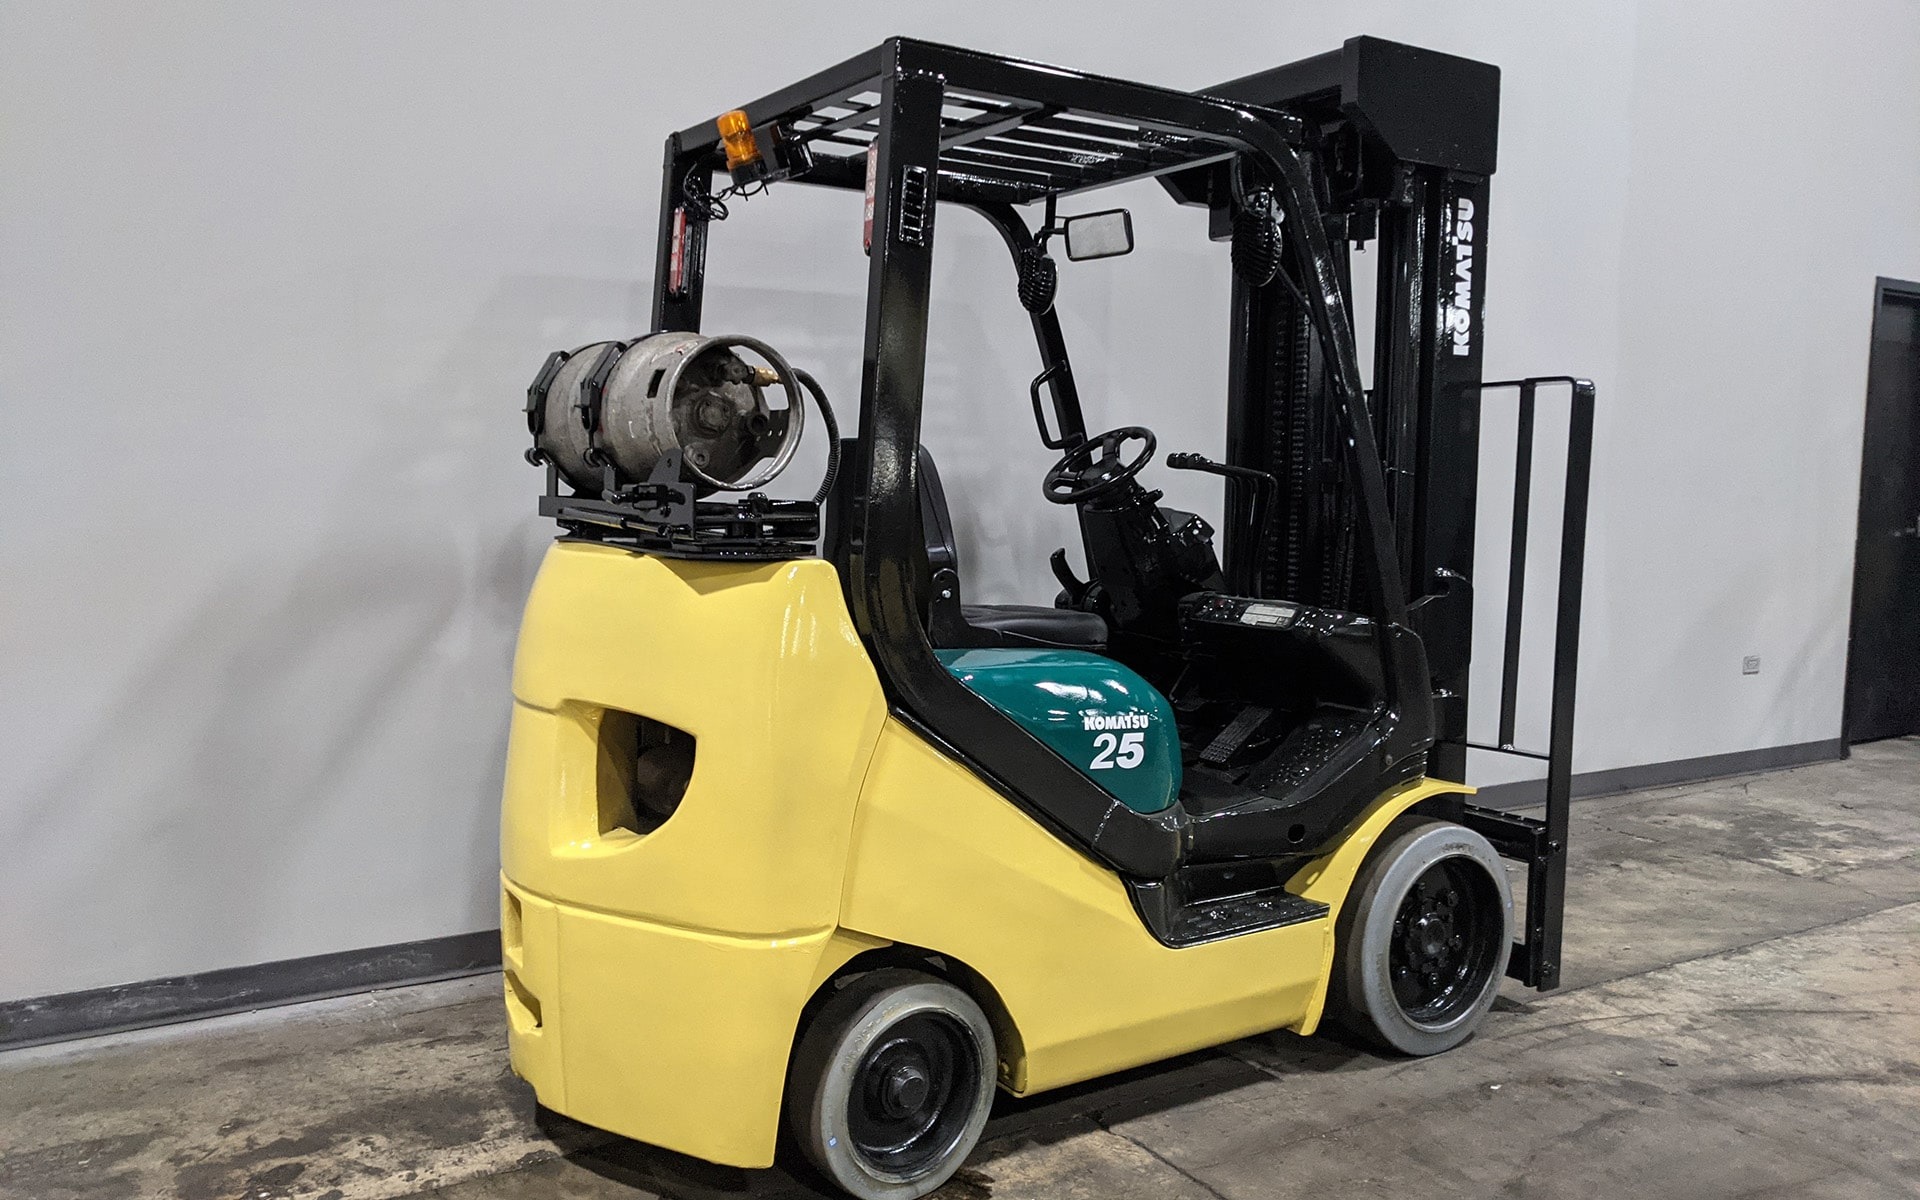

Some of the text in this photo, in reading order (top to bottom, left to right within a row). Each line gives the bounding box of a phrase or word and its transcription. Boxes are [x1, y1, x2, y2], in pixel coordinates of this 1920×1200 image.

[1452, 198, 1474, 356] KOMATSU
[1084, 713, 1149, 730] KOMATSU
[1089, 732, 1145, 769] 25
